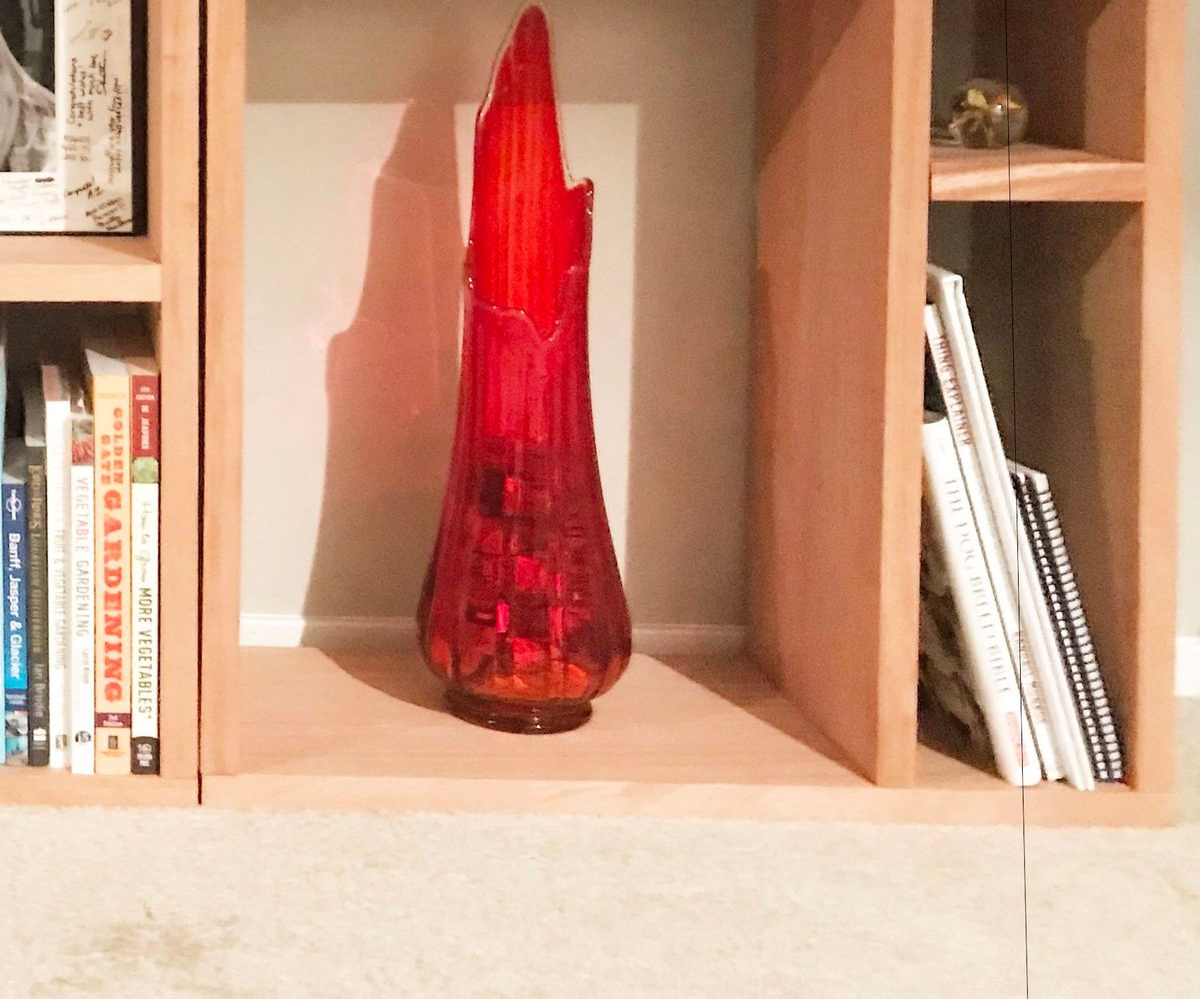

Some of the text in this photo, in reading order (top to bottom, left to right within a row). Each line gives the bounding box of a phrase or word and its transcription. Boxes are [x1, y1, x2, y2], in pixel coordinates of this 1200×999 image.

[112, 406, 125, 485] GOLDEN
[941, 378, 972, 447] EXPLAINER
[101, 433, 112, 485] GATE
[76, 477, 90, 638] VEGETABLE GARDENING
[954, 522, 978, 565] DOG
[6, 532, 24, 679] Banff, Jasper & Glacier
[103, 488, 123, 704] GARDENING
